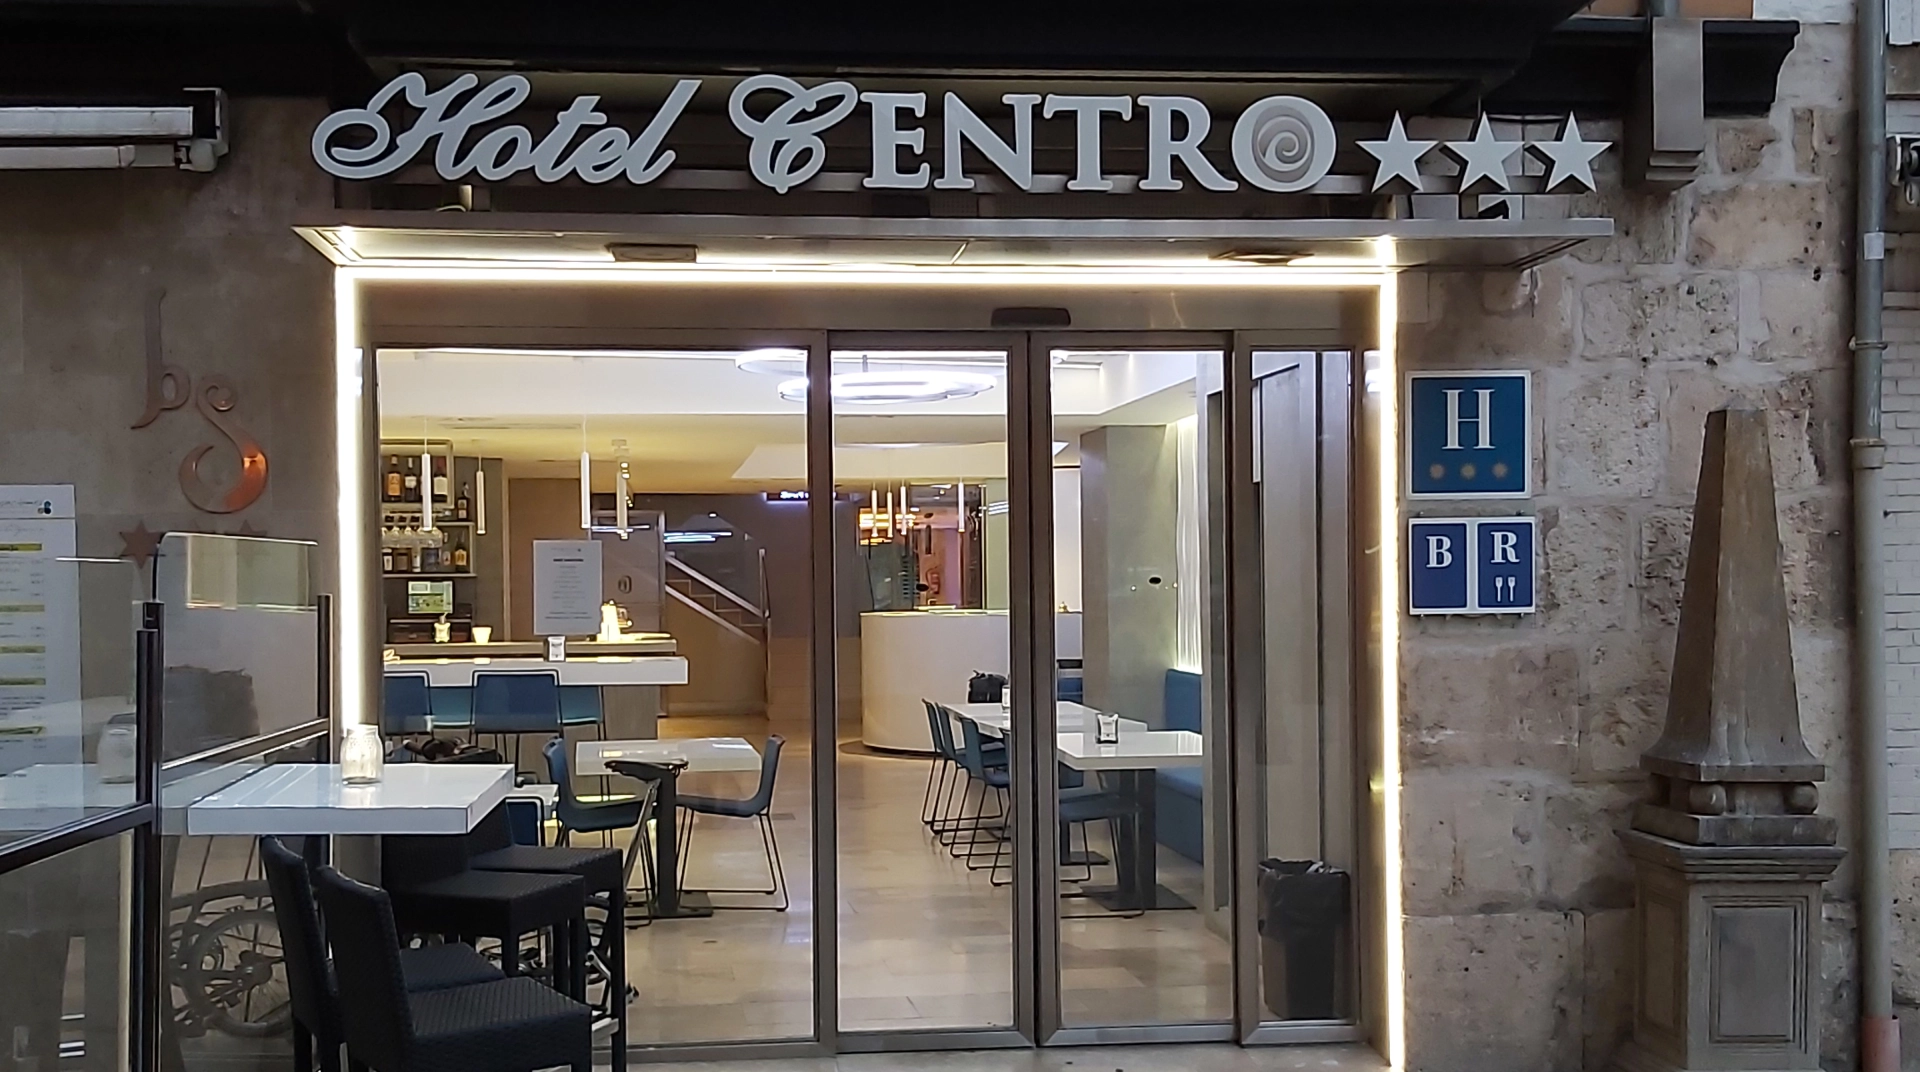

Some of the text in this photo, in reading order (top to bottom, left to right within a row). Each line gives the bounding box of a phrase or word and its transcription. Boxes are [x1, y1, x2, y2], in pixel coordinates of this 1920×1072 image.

[312, 72, 1337, 193] Hotel CENTRO
[1442, 388, 1495, 450] H
[1426, 535, 1452, 568] B
[1490, 531, 1520, 563] R
